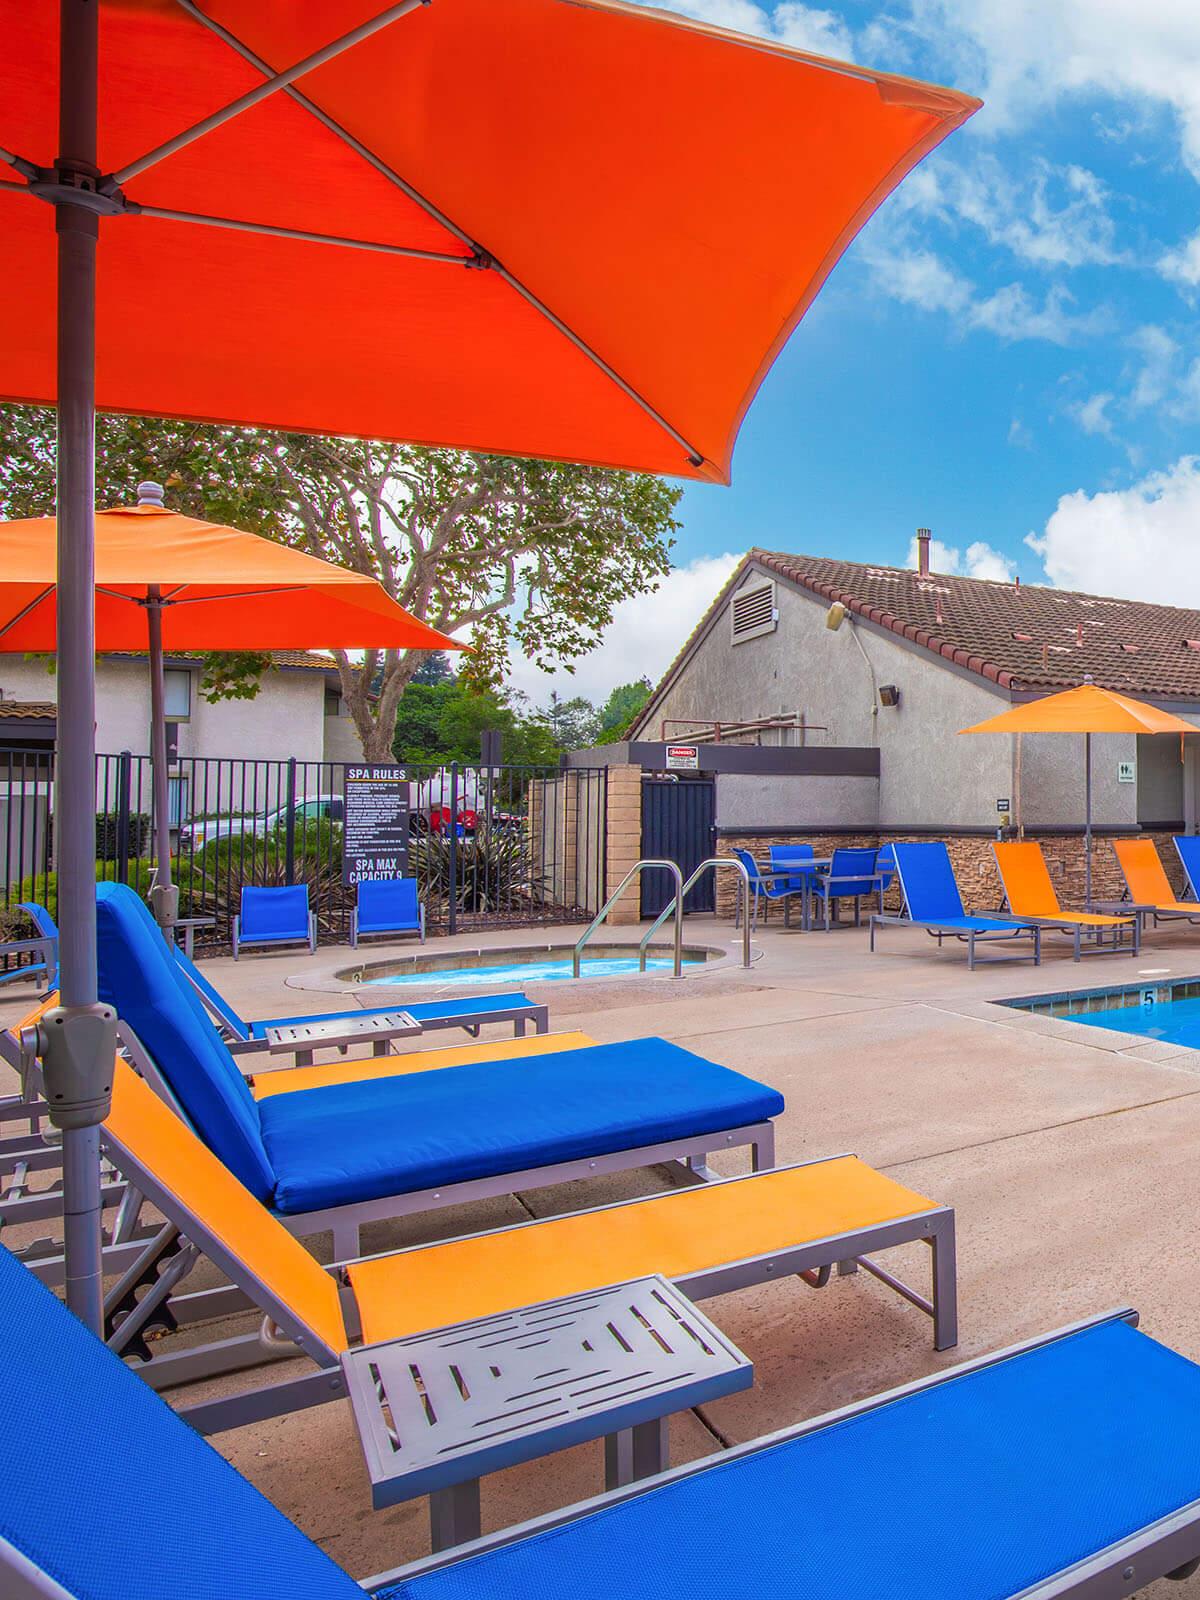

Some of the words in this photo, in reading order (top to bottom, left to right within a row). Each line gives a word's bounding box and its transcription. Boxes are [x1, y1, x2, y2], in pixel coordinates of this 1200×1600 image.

[348, 769, 370, 779] SPA
[373, 769, 406, 780] RULES
[355, 859, 374, 871] SPA
[376, 858, 397, 870] MAX
[349, 871, 394, 883] CAPACITY
[1144, 991, 1153, 1005] 5
